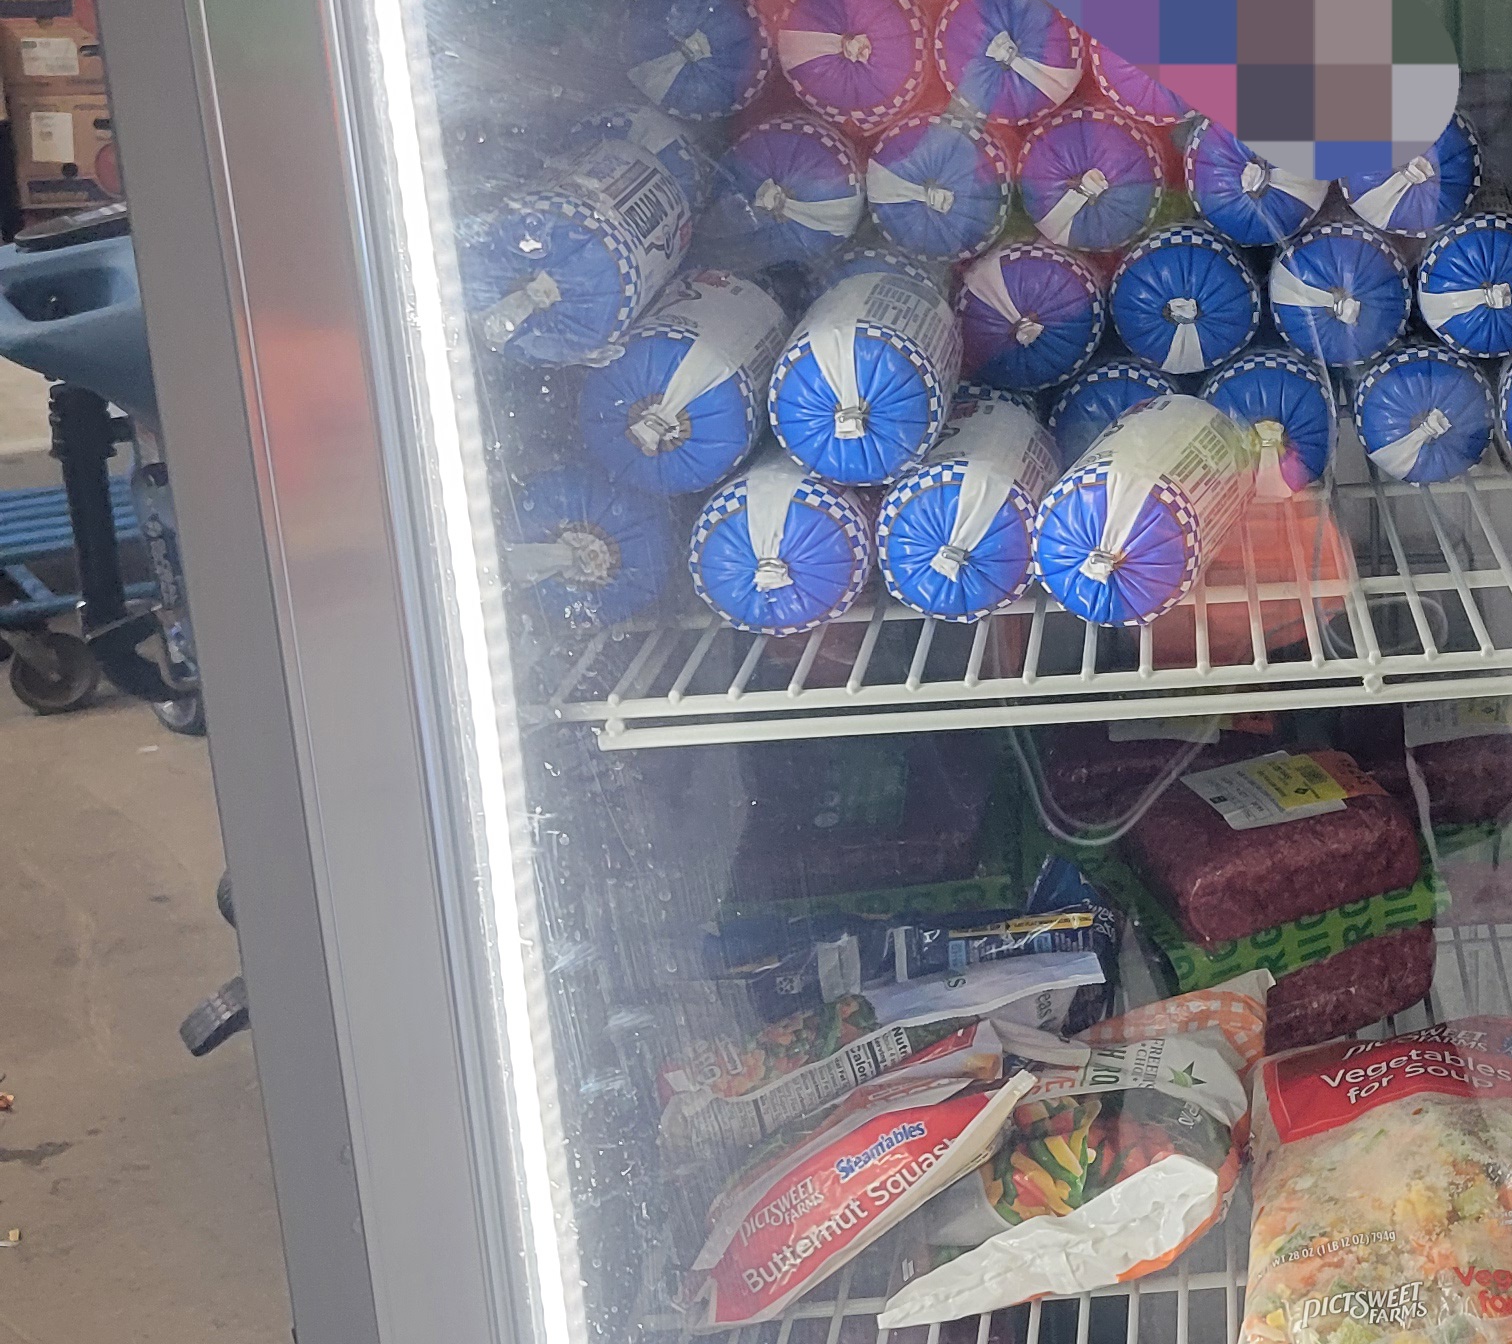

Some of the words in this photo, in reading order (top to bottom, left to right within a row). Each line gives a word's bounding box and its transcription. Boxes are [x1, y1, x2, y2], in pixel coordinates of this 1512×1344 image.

[1320, 1047, 1512, 1090] Vegetables
[1347, 1075, 1395, 1105] for
[1404, 1061, 1495, 1090] Soup
[781, 1186, 826, 1228] FARMS
[738, 1191, 871, 1298] Butternut
[1288, 1250, 1300, 1262] 28
[1302, 1247, 1315, 1258] OZ
[1327, 1241, 1341, 1253] LB
[1352, 1232, 1370, 1246] OZ)
[1371, 1229, 1397, 1244] 794g
[1300, 1280, 1425, 1330] PICTSWEET
[1368, 1301, 1429, 1325] FARMS
